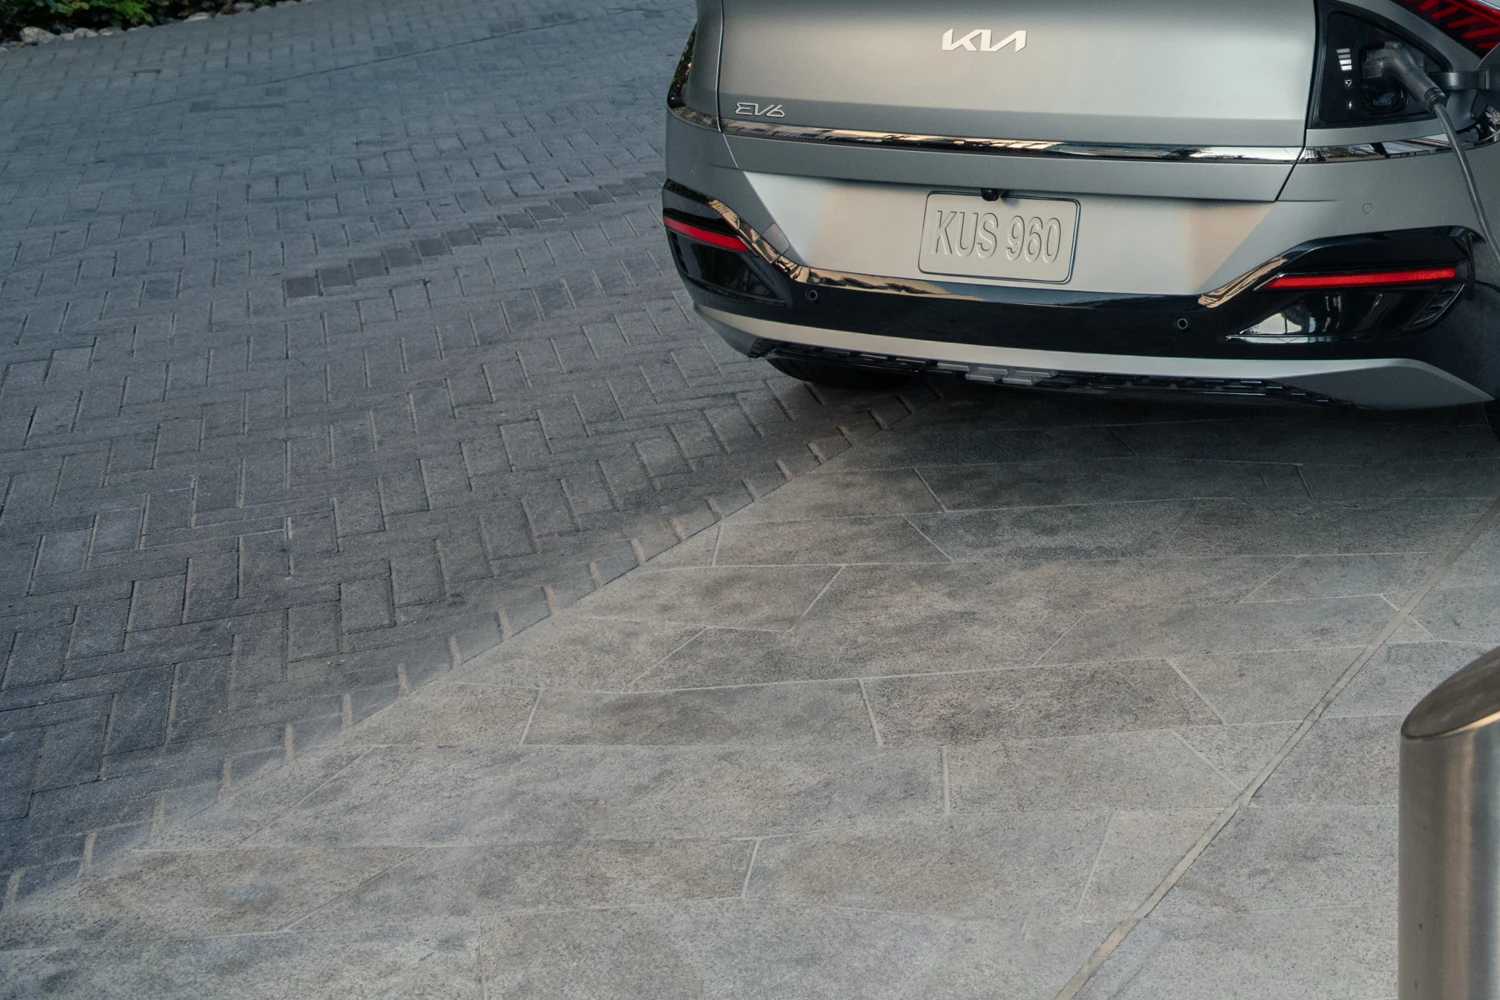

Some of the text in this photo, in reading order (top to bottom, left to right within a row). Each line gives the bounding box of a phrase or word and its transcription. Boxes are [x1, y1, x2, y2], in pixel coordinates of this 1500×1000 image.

[941, 28, 1027, 52] KIA
[735, 101, 786, 118] EV6
[931, 210, 1062, 264] KUS 960
